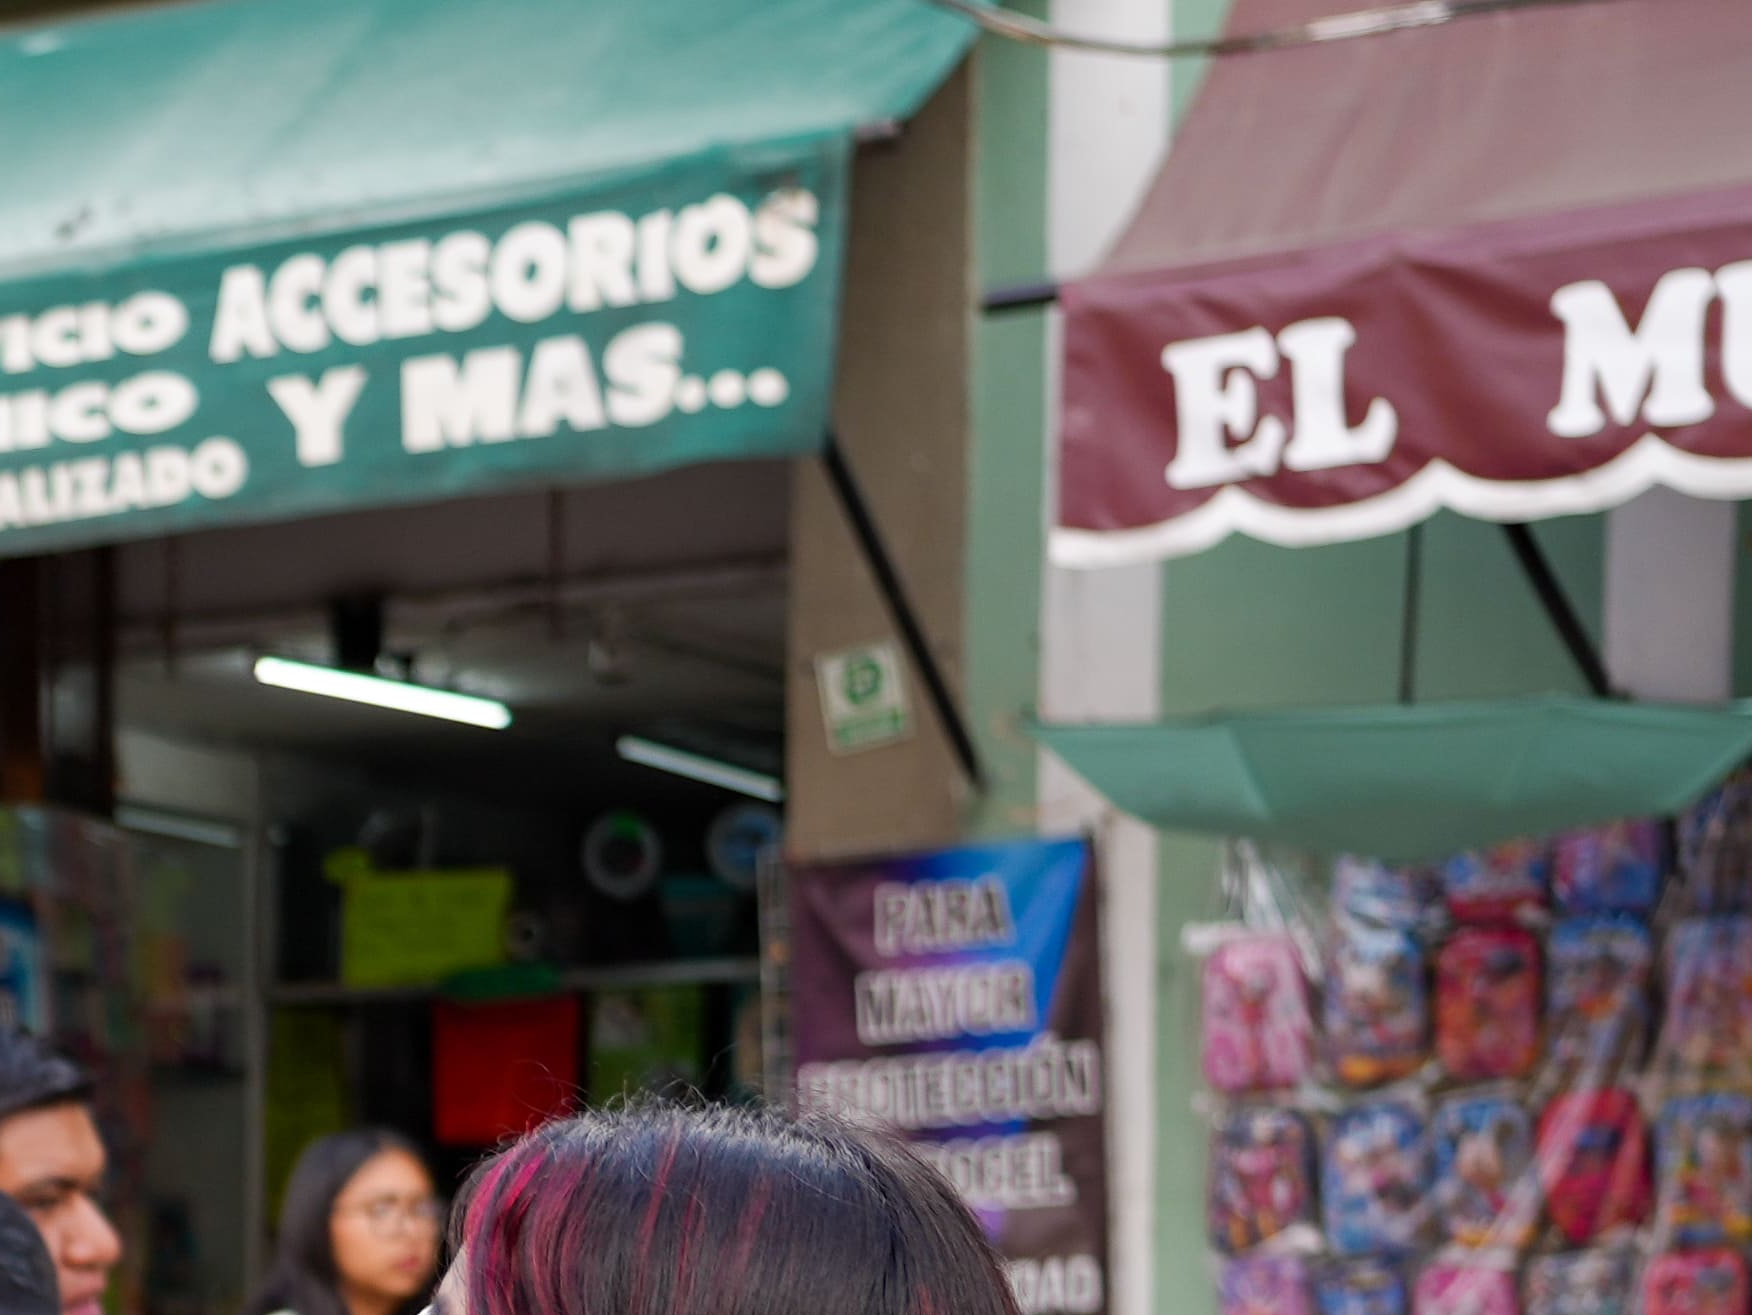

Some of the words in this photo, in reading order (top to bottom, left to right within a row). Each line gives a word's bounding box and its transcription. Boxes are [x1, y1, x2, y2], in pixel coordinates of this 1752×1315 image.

[208, 187, 819, 363] ACCESORIOS
[266, 364, 369, 467] Y
[400, 321, 788, 454] MAS...
[1160, 316, 1397, 490] EL
[876, 878, 1012, 954] PARA
[856, 964, 1034, 1042] MAYOR
